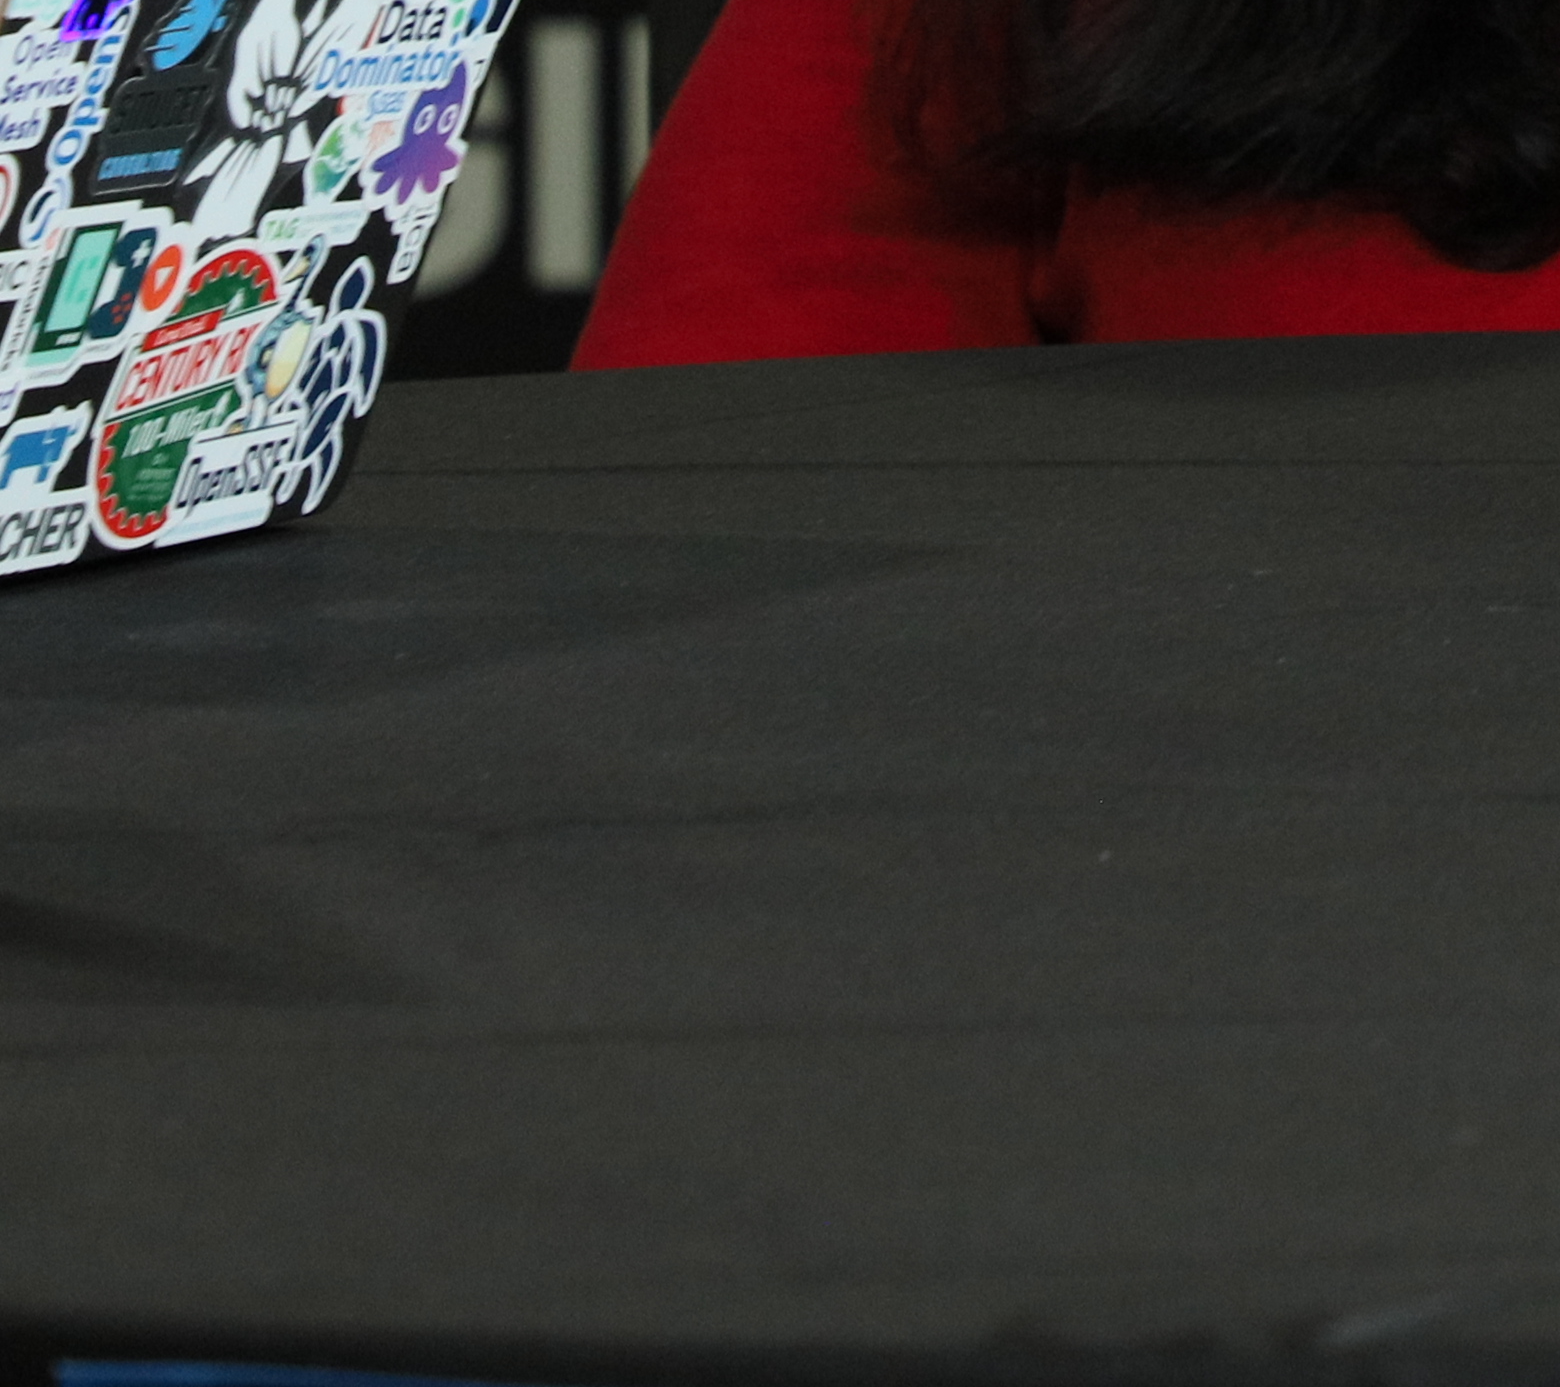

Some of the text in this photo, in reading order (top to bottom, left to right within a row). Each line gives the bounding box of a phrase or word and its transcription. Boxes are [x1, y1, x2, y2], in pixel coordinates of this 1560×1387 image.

[14, 33, 73, 73] Open
[313, 43, 461, 91] Dominator
[0, 69, 78, 104] Service
[115, 334, 232, 411] CENTURY
[175, 437, 291, 517] OpenSSF
